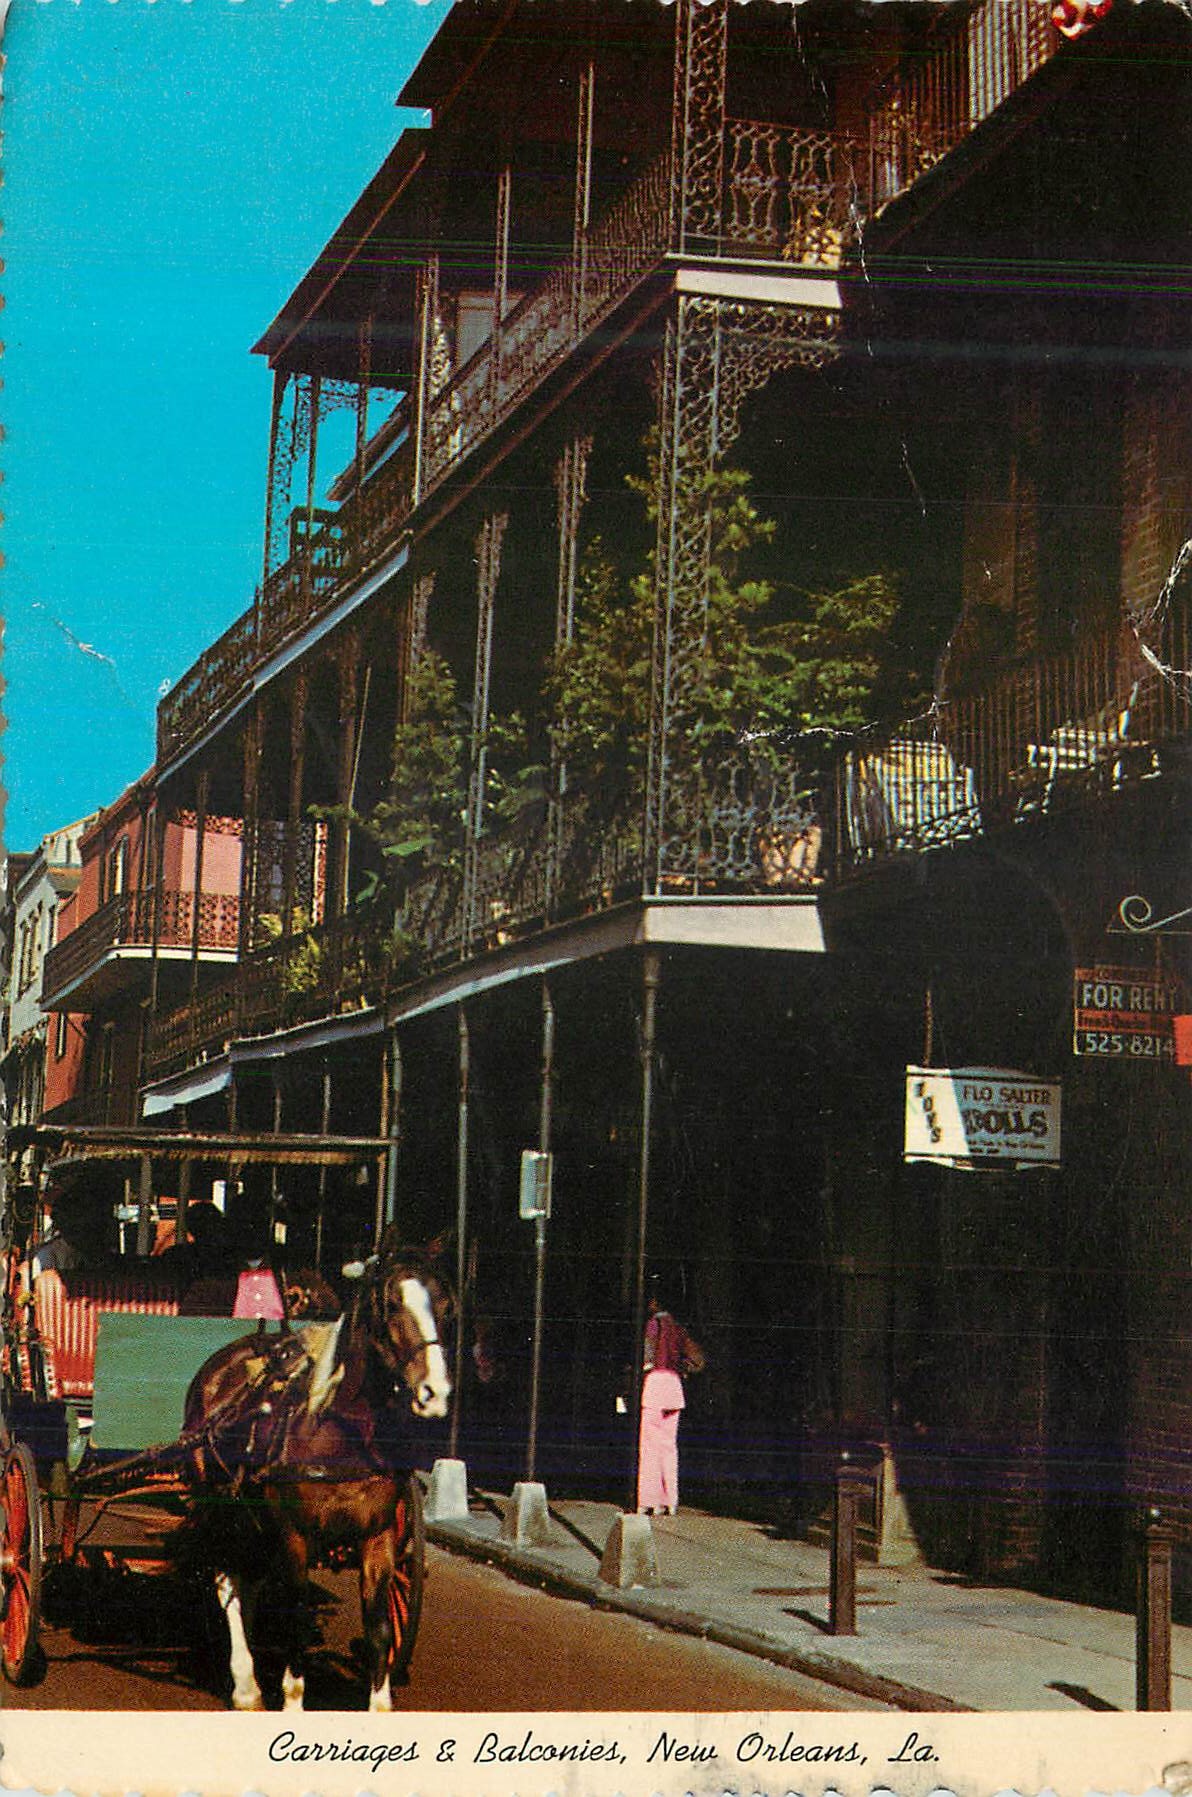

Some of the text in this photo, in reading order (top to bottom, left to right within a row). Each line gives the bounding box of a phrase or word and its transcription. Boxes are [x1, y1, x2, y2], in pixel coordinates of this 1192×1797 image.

[1082, 982, 1177, 1011] FOR RENT
[963, 1085, 1052, 1105] FLO SALTER
